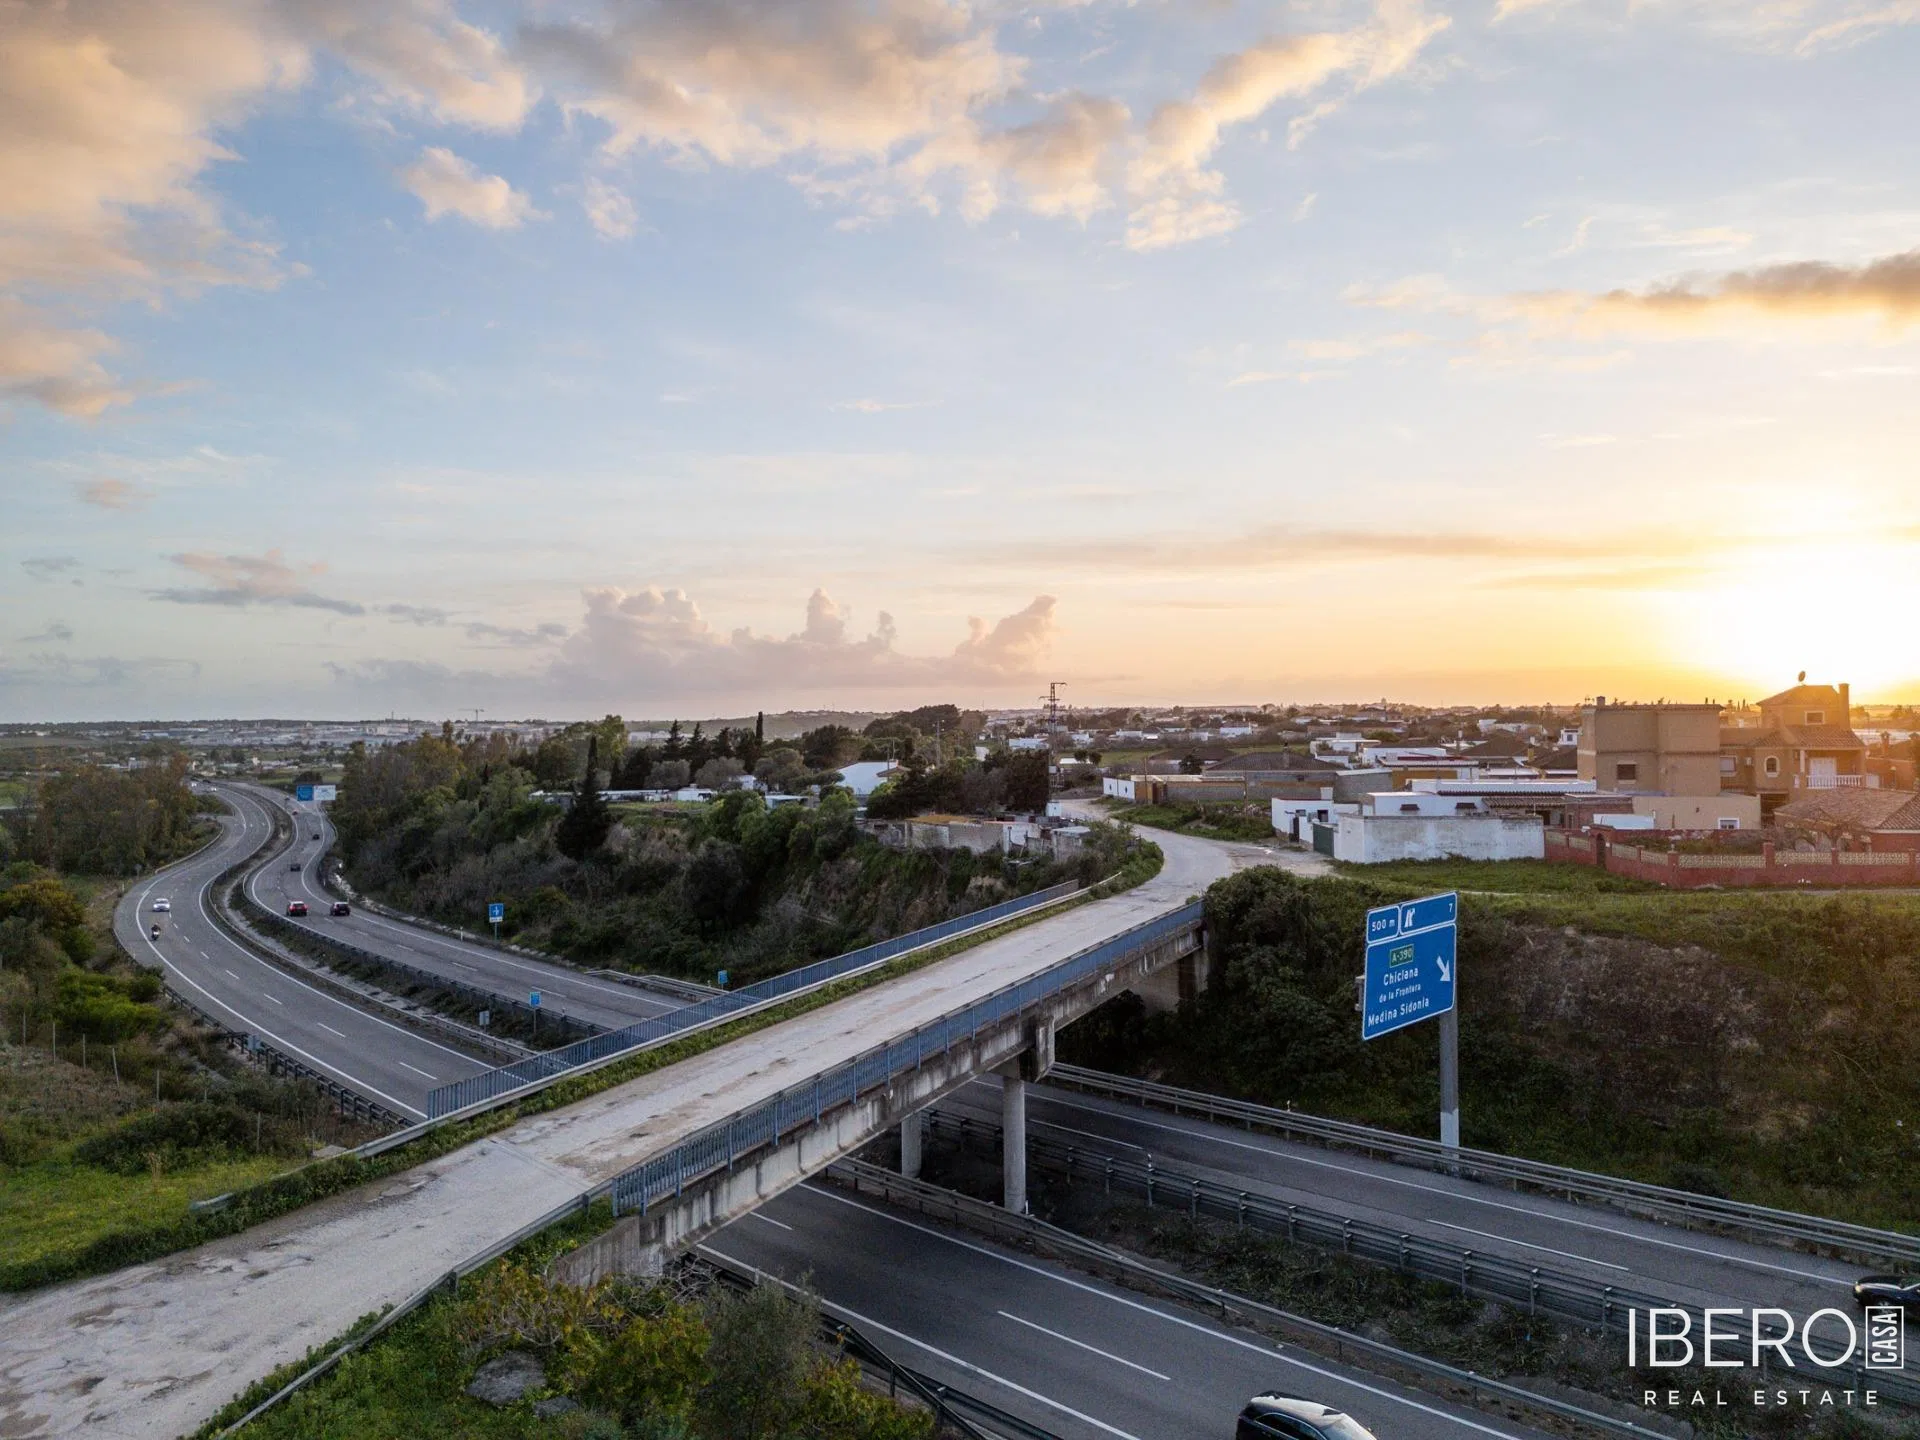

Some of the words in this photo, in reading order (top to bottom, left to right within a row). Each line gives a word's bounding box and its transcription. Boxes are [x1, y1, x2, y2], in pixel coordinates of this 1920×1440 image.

[1448, 903, 1453, 913] 7
[1371, 919, 1387, 932] 500
[1388, 919, 1395, 927] m
[1391, 947, 1413, 962] A-390
[1383, 967, 1419, 986] Chiclana
[1379, 993, 1387, 1003] de
[1388, 991, 1394, 1001] la
[1395, 983, 1421, 998] Frontera
[1367, 1008, 1398, 1027] Medina
[1400, 996, 1429, 1016] Sidonia
